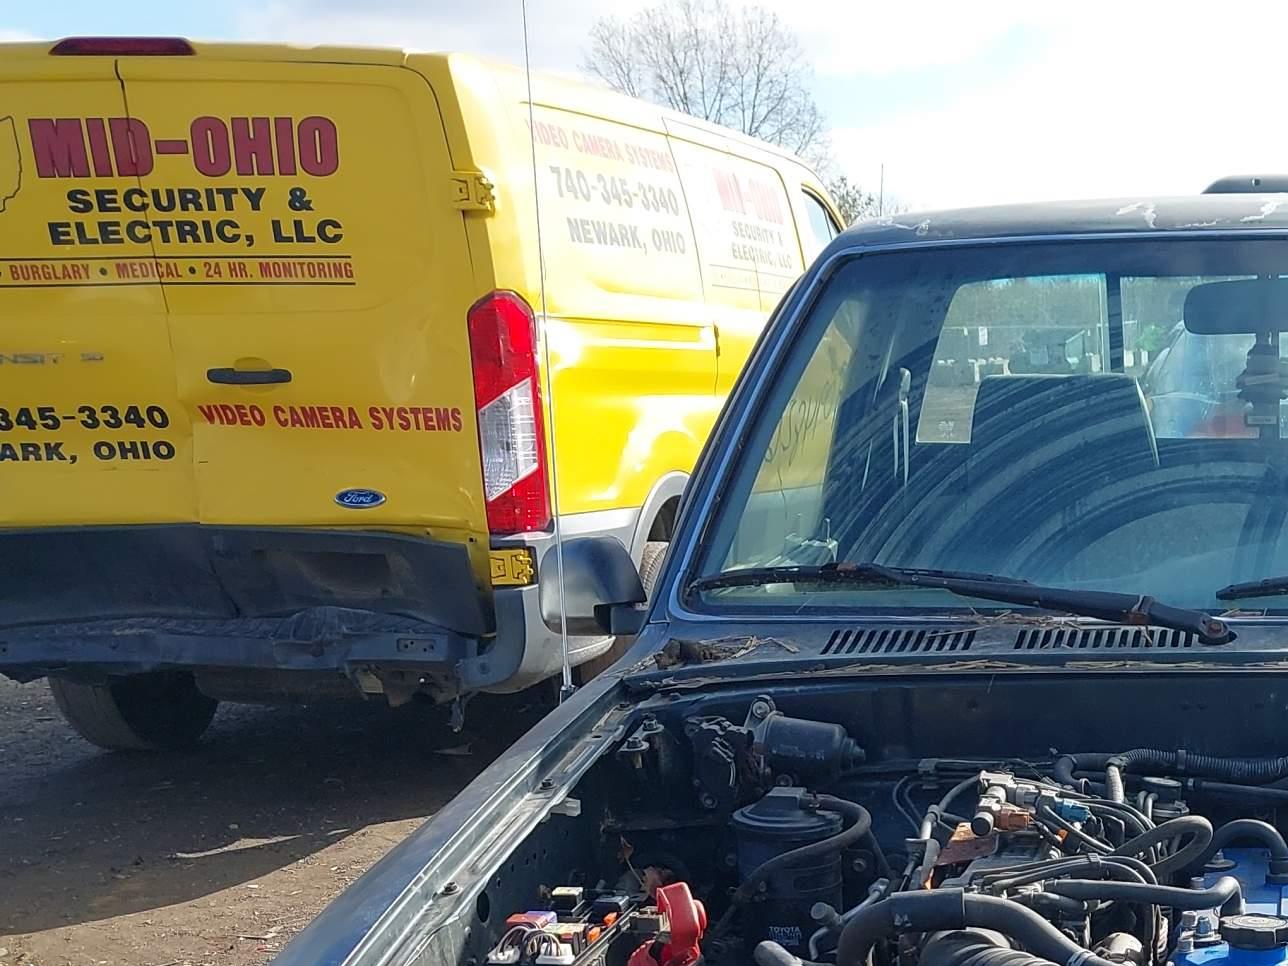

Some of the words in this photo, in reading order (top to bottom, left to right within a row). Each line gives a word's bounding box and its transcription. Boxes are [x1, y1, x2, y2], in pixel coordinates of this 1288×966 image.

[28, 115, 339, 179] MID-OHIO
[572, 130, 624, 162] CAMERA
[624, 143, 674, 173] SYSTEMS
[66, 187, 267, 214] SECURITY
[287, 187, 315, 213] &
[548, 165, 679, 217] 740-345-3340
[47, 219, 255, 247] ELECTRIC,
[271, 219, 344, 245] LLC
[566, 217, 648, 255] NEWARK,
[651, 228, 685, 254] OHIO
[731, 220, 775, 244] SECURITY
[9, 264, 91, 281] BURGLARY
[116, 262, 183, 279] MEDICAL
[204, 262, 224, 278] 24
[228, 262, 254, 279] HR.
[259, 261, 354, 280] MONITORING
[198, 404, 267, 427] VIDEO
[273, 405, 362, 430] CAMERA
[370, 406, 464, 433] SYSTEMS
[93, 440, 176, 460] OHIO
